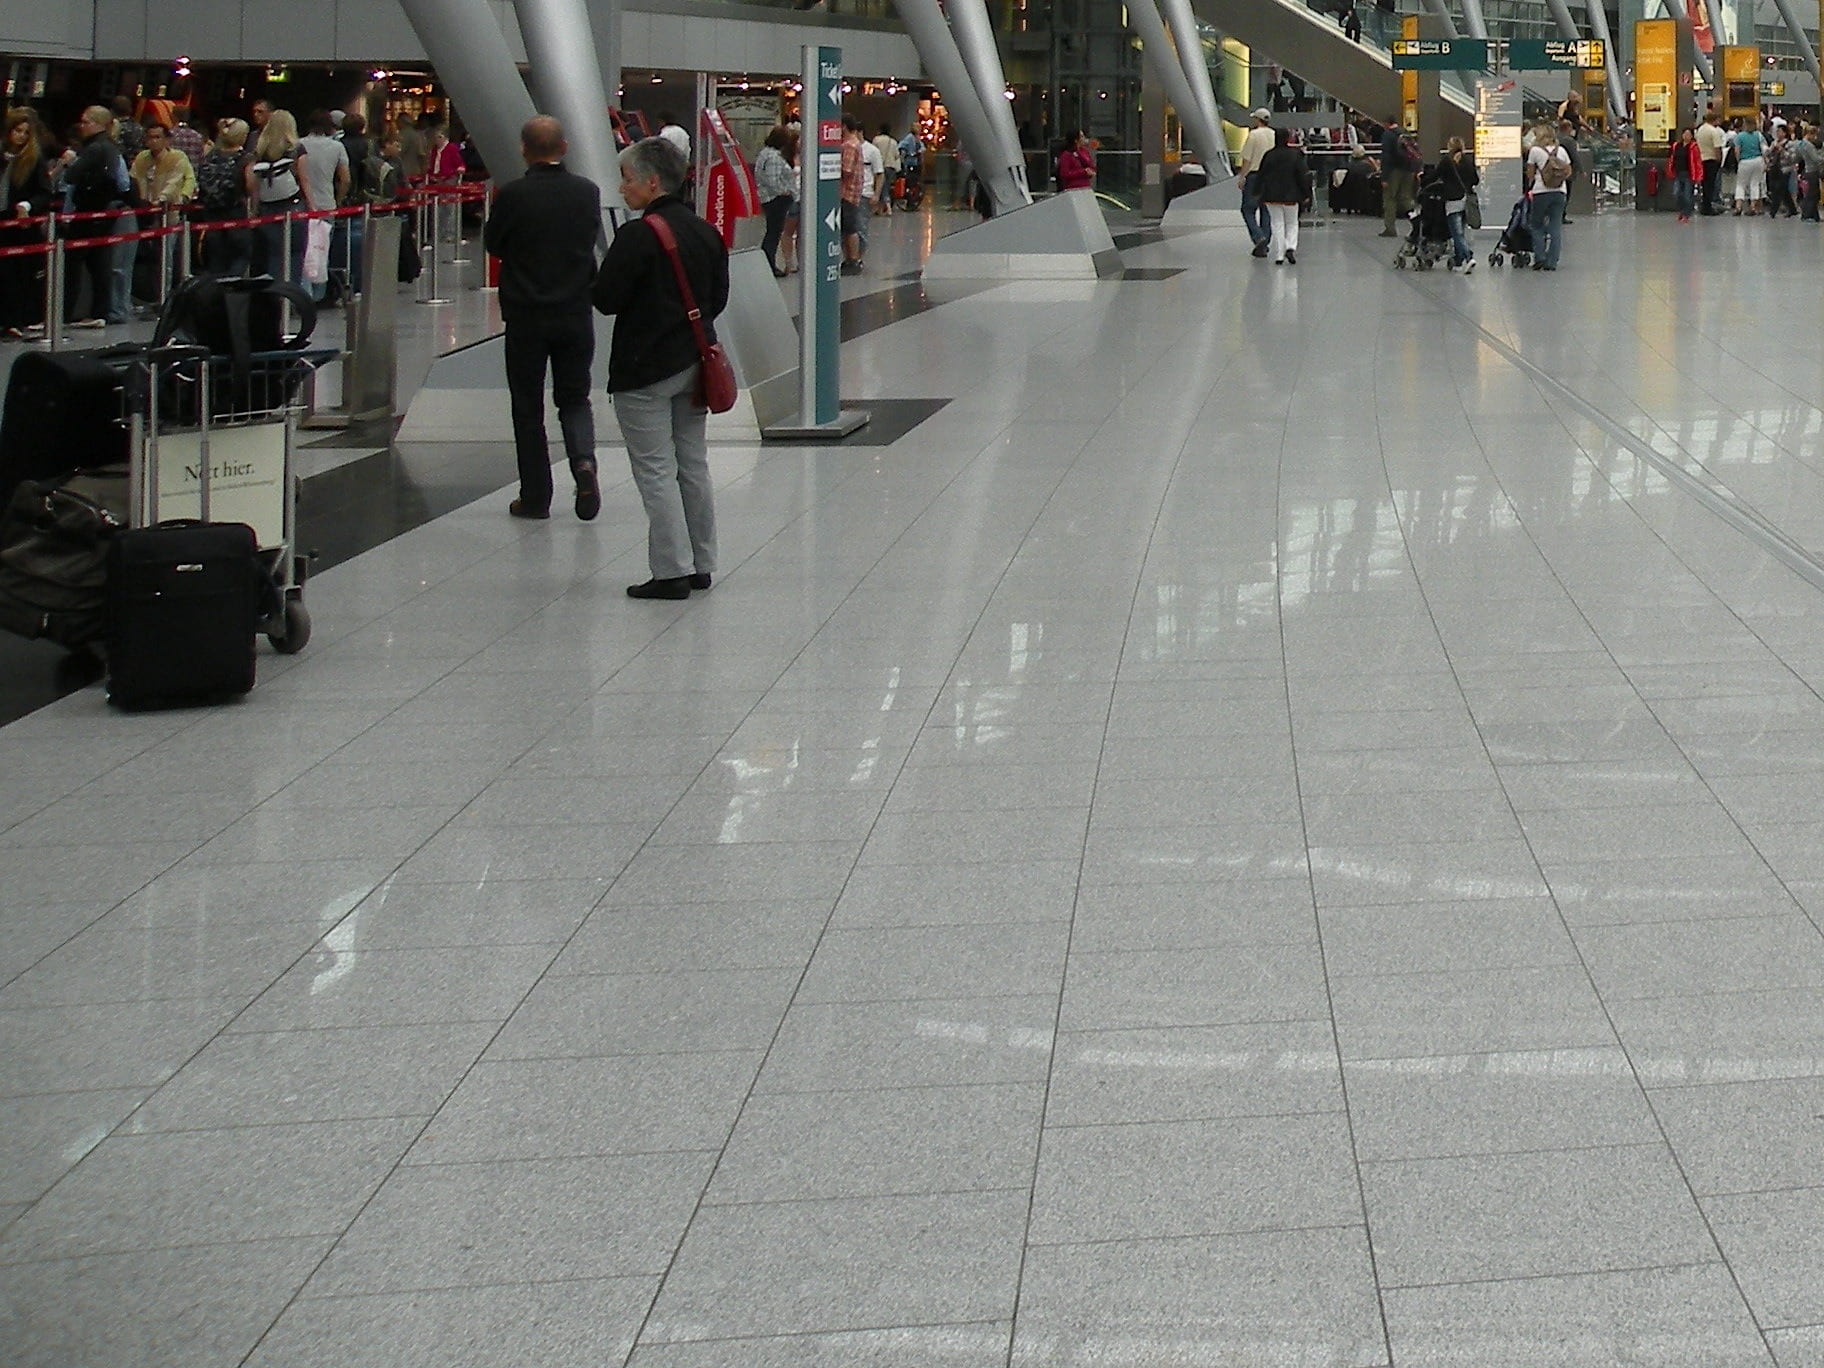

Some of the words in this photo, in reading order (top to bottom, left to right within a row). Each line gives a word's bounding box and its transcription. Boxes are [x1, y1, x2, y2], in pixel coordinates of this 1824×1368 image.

[1441, 41, 1451, 54] B
[1567, 41, 1577, 53] A
[222, 460, 255, 478] hier.
